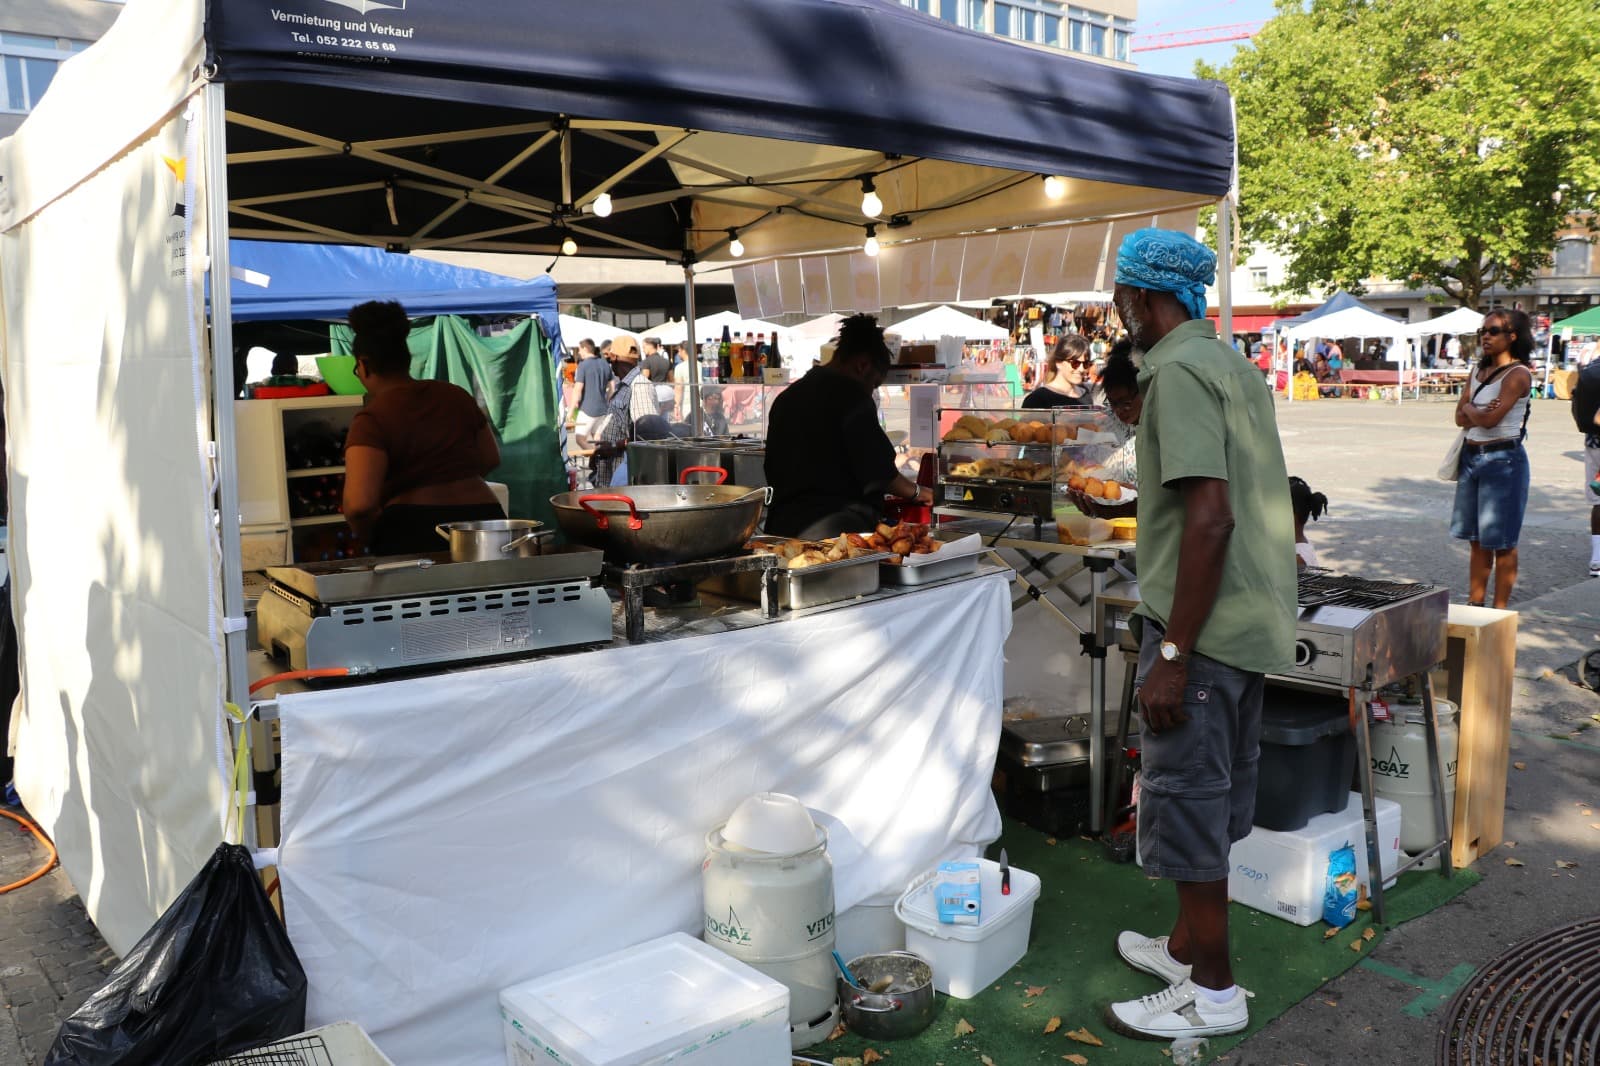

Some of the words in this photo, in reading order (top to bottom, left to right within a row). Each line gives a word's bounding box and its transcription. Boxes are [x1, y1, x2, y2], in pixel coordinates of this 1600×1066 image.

[271, 9, 341, 32] Vermietung
[344, 21, 367, 33] und
[369, 22, 415, 39] Verkauf
[291, 32, 314, 44] Tel.
[316, 35, 339, 46] 052
[340, 38, 363, 49] 222
[365, 41, 380, 51] 65
[1371, 757, 1409, 774] OGAZ
[706, 914, 751, 941] TOGAZ
